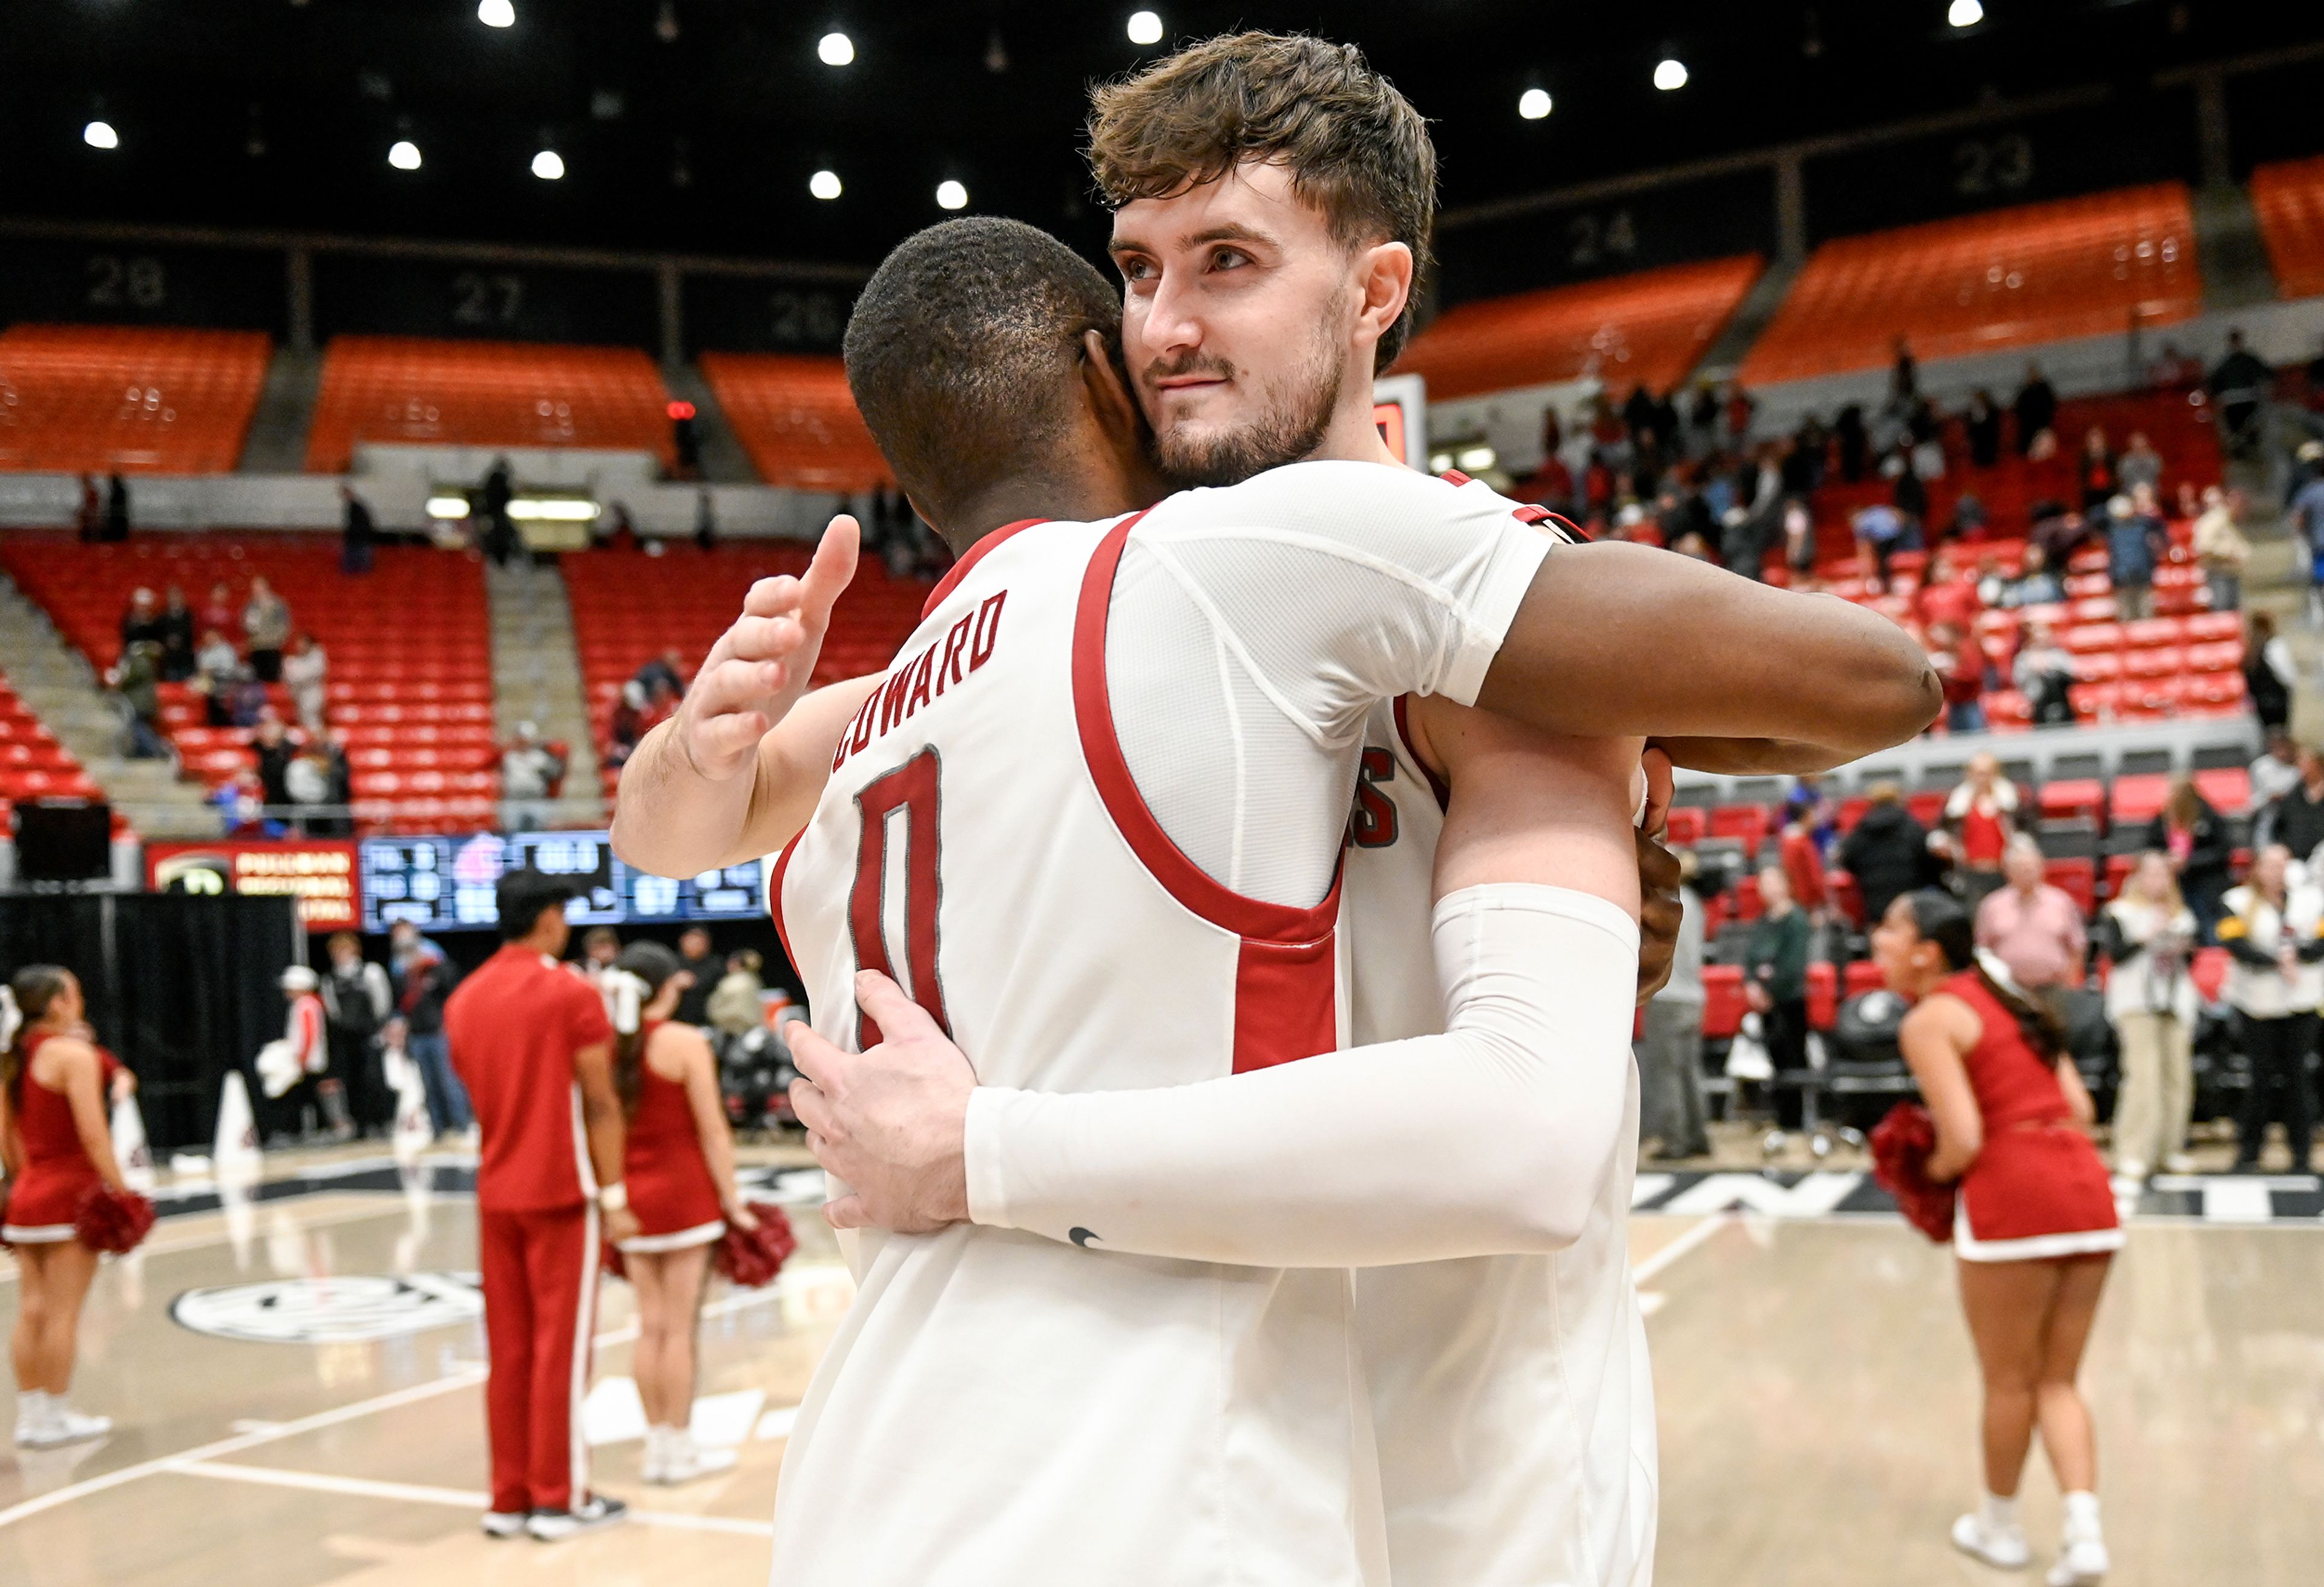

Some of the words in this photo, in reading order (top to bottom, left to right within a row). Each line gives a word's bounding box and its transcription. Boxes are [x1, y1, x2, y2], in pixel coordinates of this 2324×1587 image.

[1953, 133, 2036, 194] 23
[1566, 208, 1638, 266] 24
[88, 255, 165, 307] 28
[453, 272, 525, 323] 27
[832, 590, 1008, 774] COWARD
[847, 742, 953, 1053] 0
